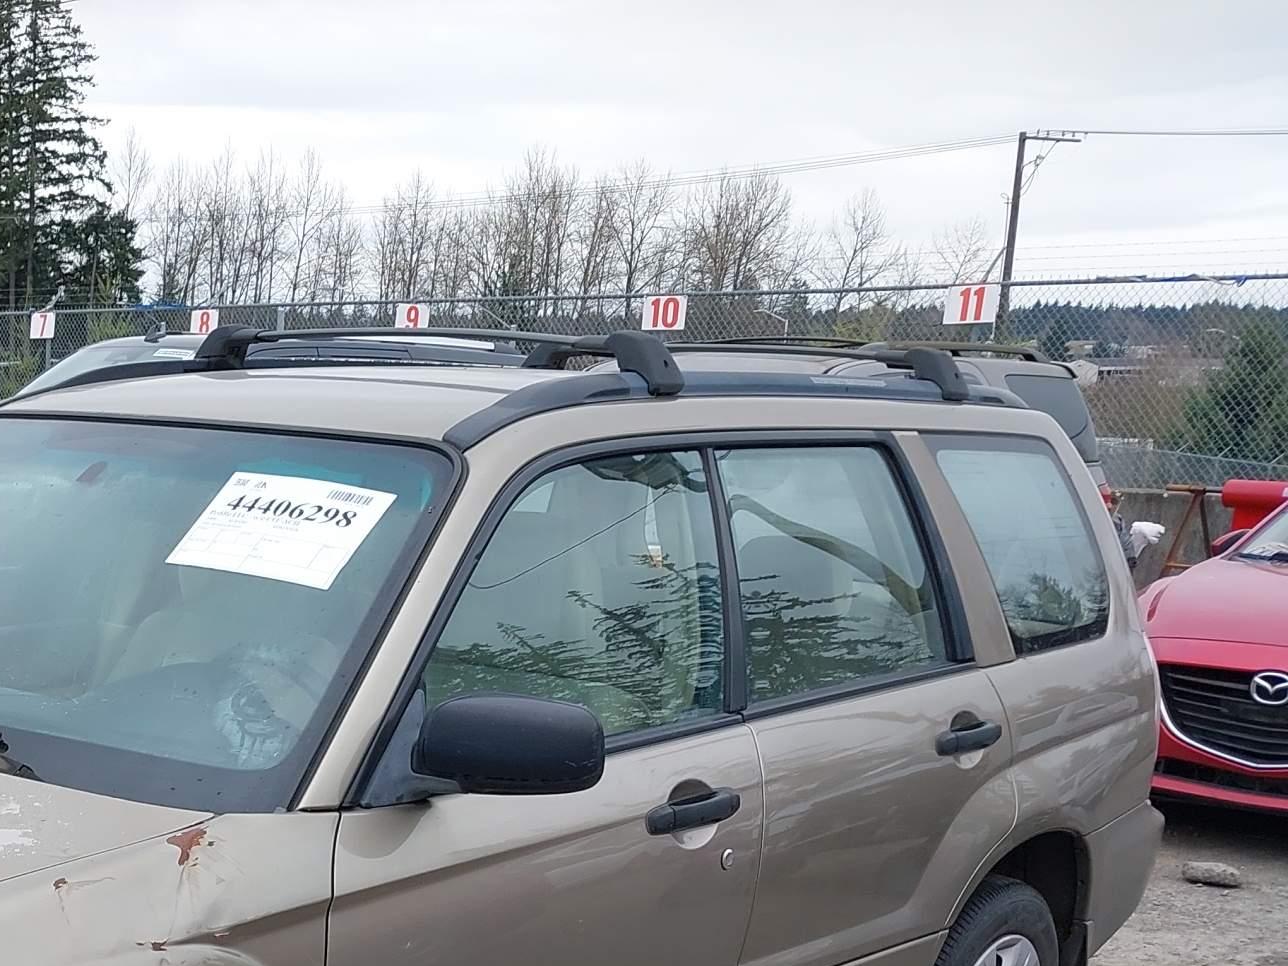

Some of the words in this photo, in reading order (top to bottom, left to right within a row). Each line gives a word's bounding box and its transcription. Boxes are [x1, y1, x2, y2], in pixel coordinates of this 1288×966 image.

[406, 306, 419, 328] 9
[651, 298, 680, 328] 10
[959, 287, 986, 322] 11
[39, 314, 48, 337] 7
[199, 311, 210, 333] 8
[227, 494, 357, 528] 44406298
